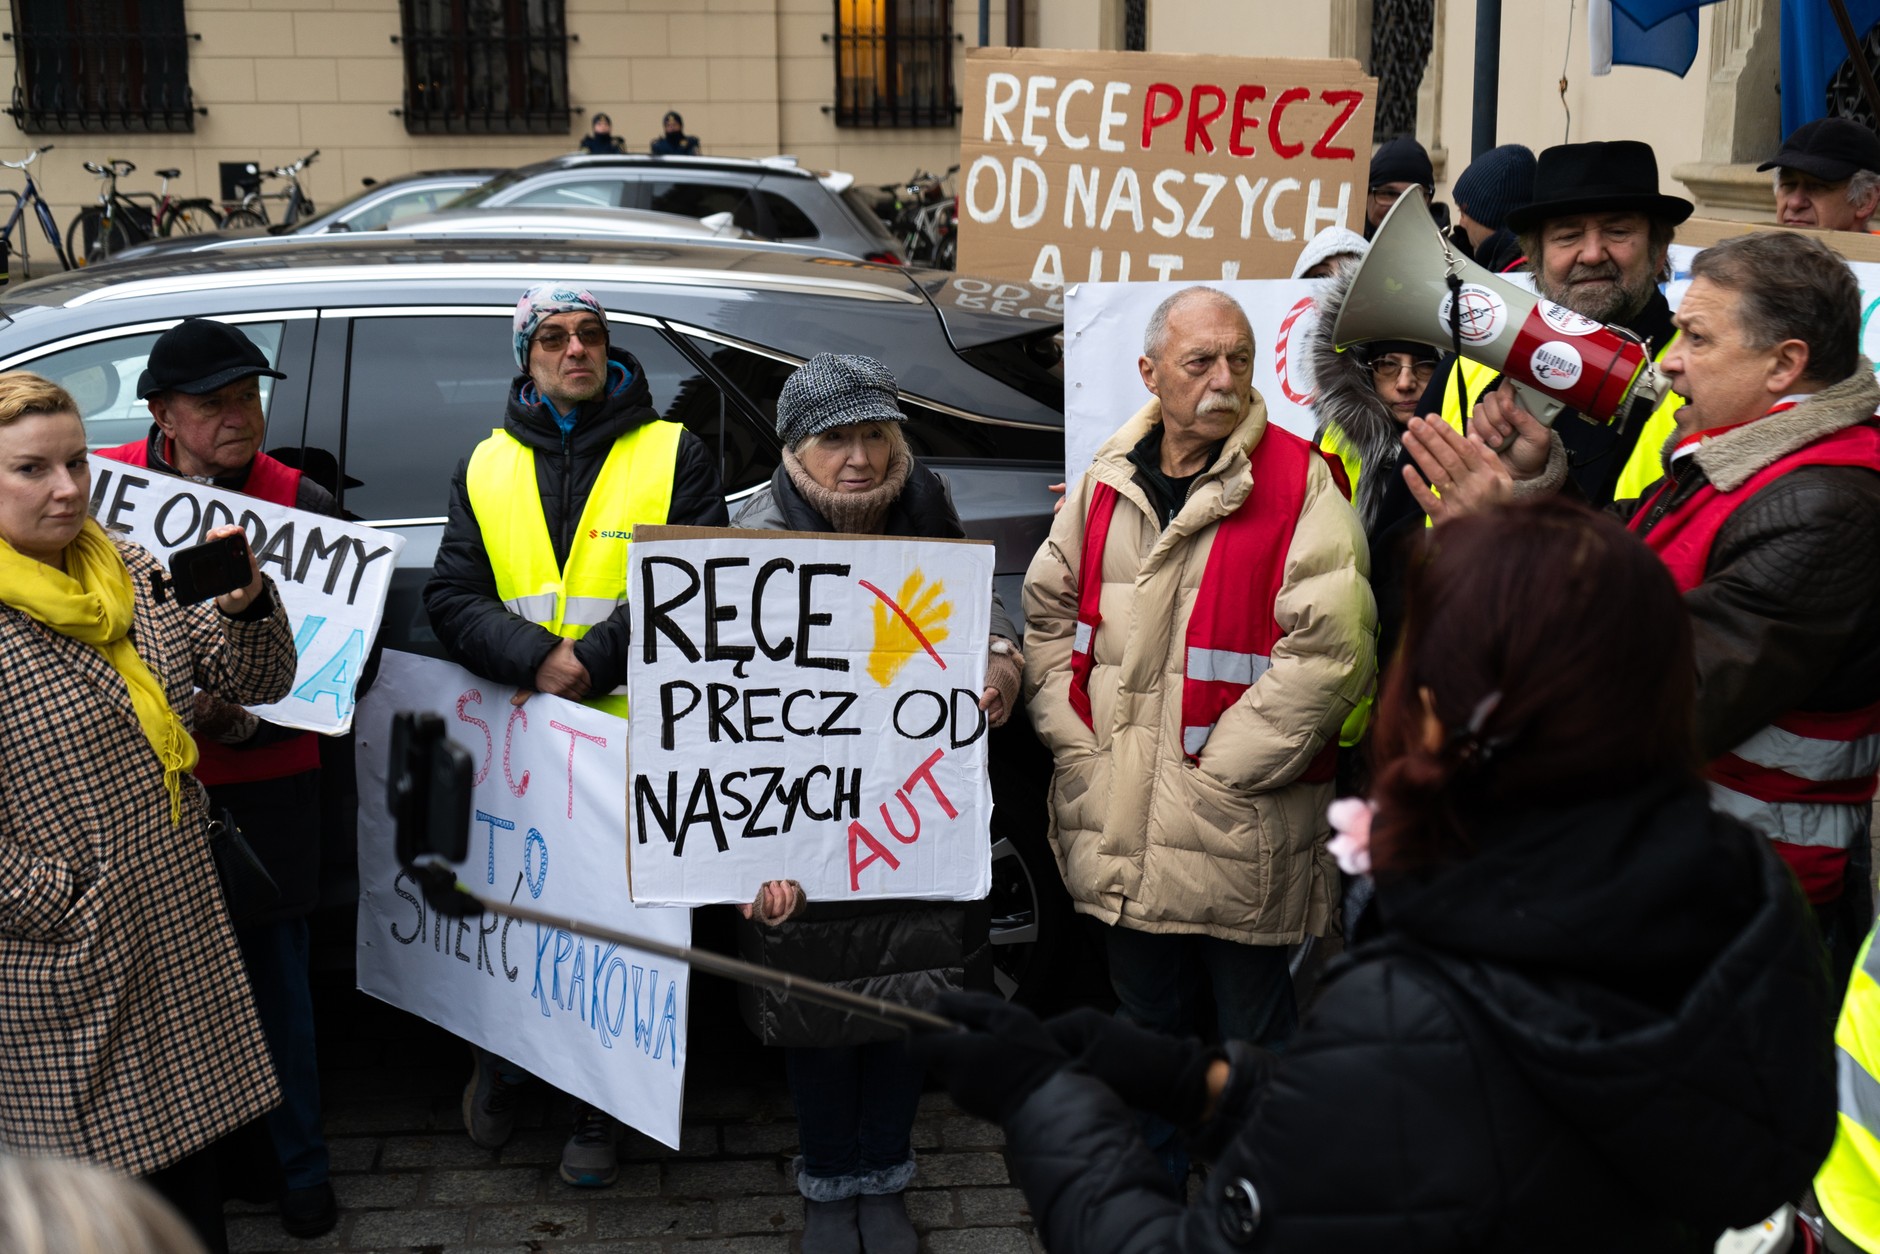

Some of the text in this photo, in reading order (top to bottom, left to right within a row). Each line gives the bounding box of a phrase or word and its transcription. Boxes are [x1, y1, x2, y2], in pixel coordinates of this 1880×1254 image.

[983, 72, 1364, 161] RĘCE PRECZ
[965, 155, 1351, 242] OD NASZYCH
[88, 469, 150, 534] IE
[601, 531, 633, 539] SUZU
[641, 557, 851, 678] RĘCE
[457, 689, 607, 819] SCT
[660, 679, 987, 750] PRECZ OD
[476, 810, 548, 899] TO
[634, 748, 959, 892] NASZYCH AUT
[531, 921, 676, 1069] KRAKOWA
